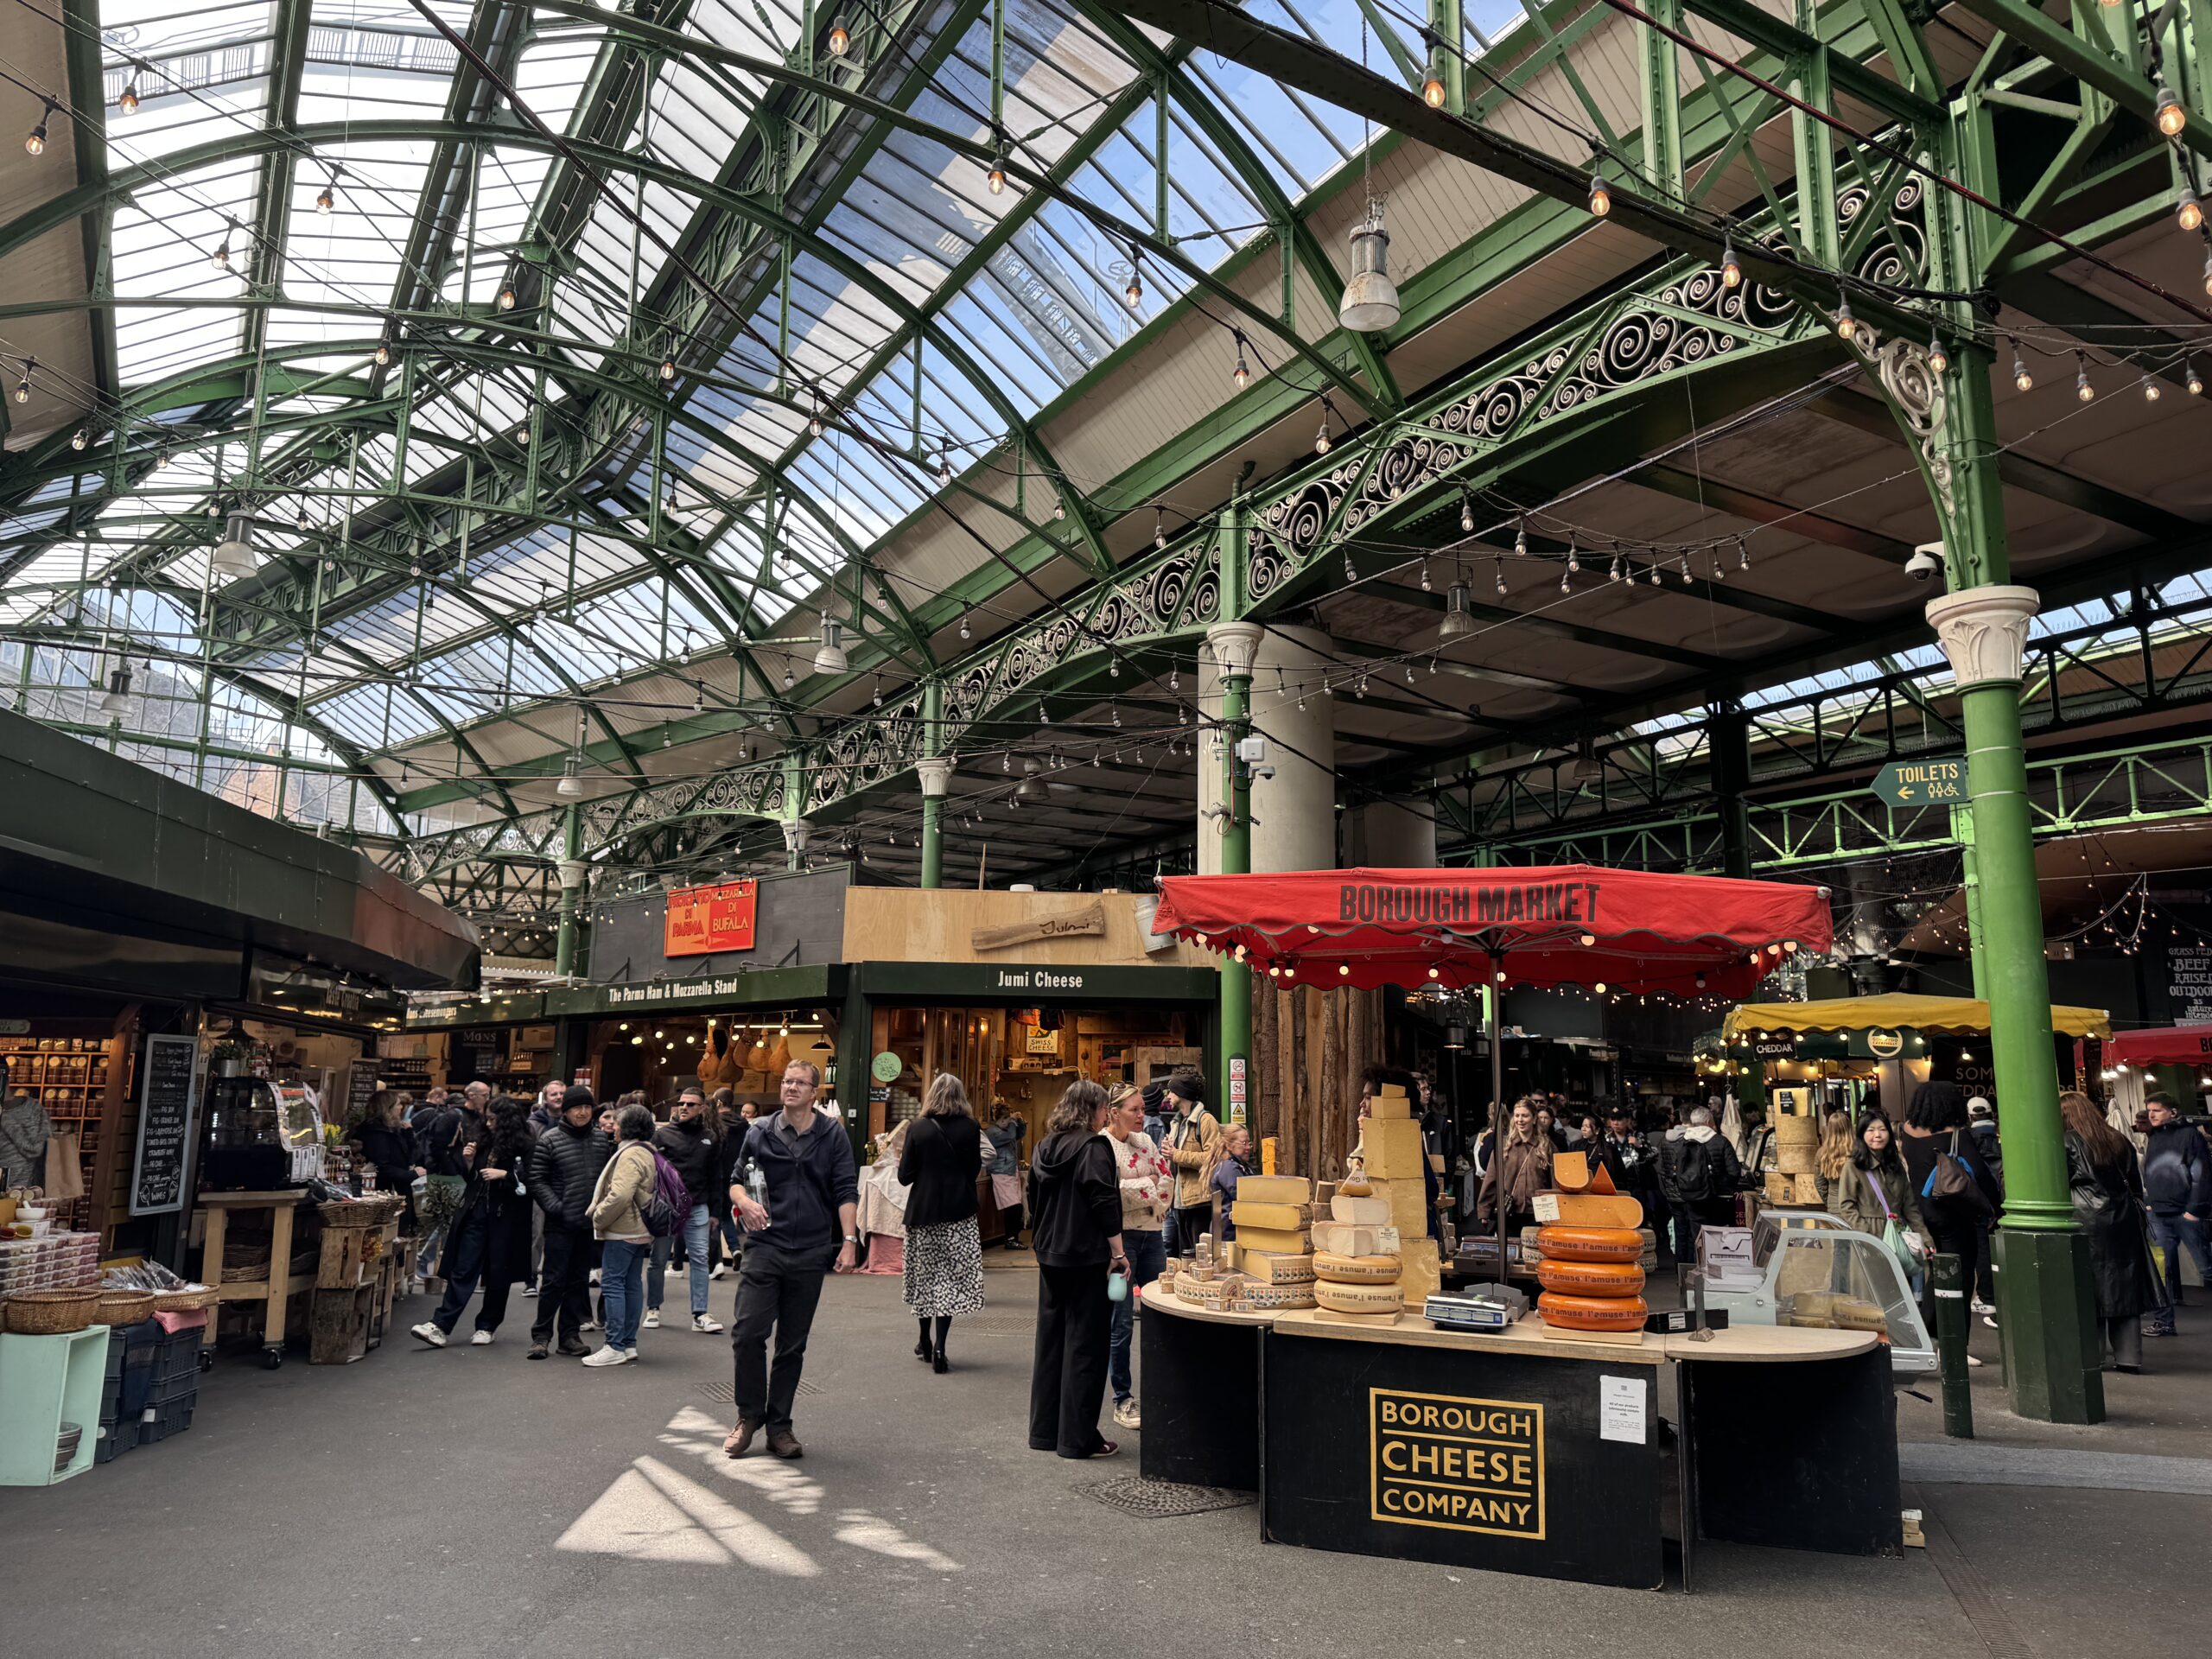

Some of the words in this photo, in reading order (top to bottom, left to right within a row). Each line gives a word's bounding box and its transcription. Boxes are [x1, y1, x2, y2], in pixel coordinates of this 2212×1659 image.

[1895, 763, 1959, 784] TOILETS
[728, 902, 737, 915] DI
[1339, 885, 1469, 923] BOROUGH
[1478, 882, 1600, 923] MARKET
[672, 920, 704, 938] PARMA
[712, 916, 749, 933] BUFALA
[2173, 958, 2210, 972] BEEF
[998, 970, 1029, 987] Jumi
[1034, 970, 1083, 988] Cheese
[609, 988, 621, 1002] The
[623, 987, 645, 1001] Parma
[646, 985, 663, 1000] Ham
[664, 983, 671, 998] &
[672, 981, 712, 998] Mozzarella
[715, 978, 737, 995] Stand
[1756, 1043, 1794, 1055] CHEDDAR
[1547, 1239, 1578, 1249] l'amuse
[1583, 1243, 1618, 1251] l'amuse
[1339, 1266, 1372, 1274] l'amuse
[1548, 1272, 1580, 1282] l'amuse
[1585, 1275, 1621, 1284] l'amuse
[1332, 1292, 1363, 1302] l'amuse
[1551, 1307, 1583, 1317] l'amuse
[1382, 1401, 1531, 1437] BOROUGH
[1382, 1440, 1532, 1485] CHEESE
[1382, 1488, 1532, 1525] COMPANY
